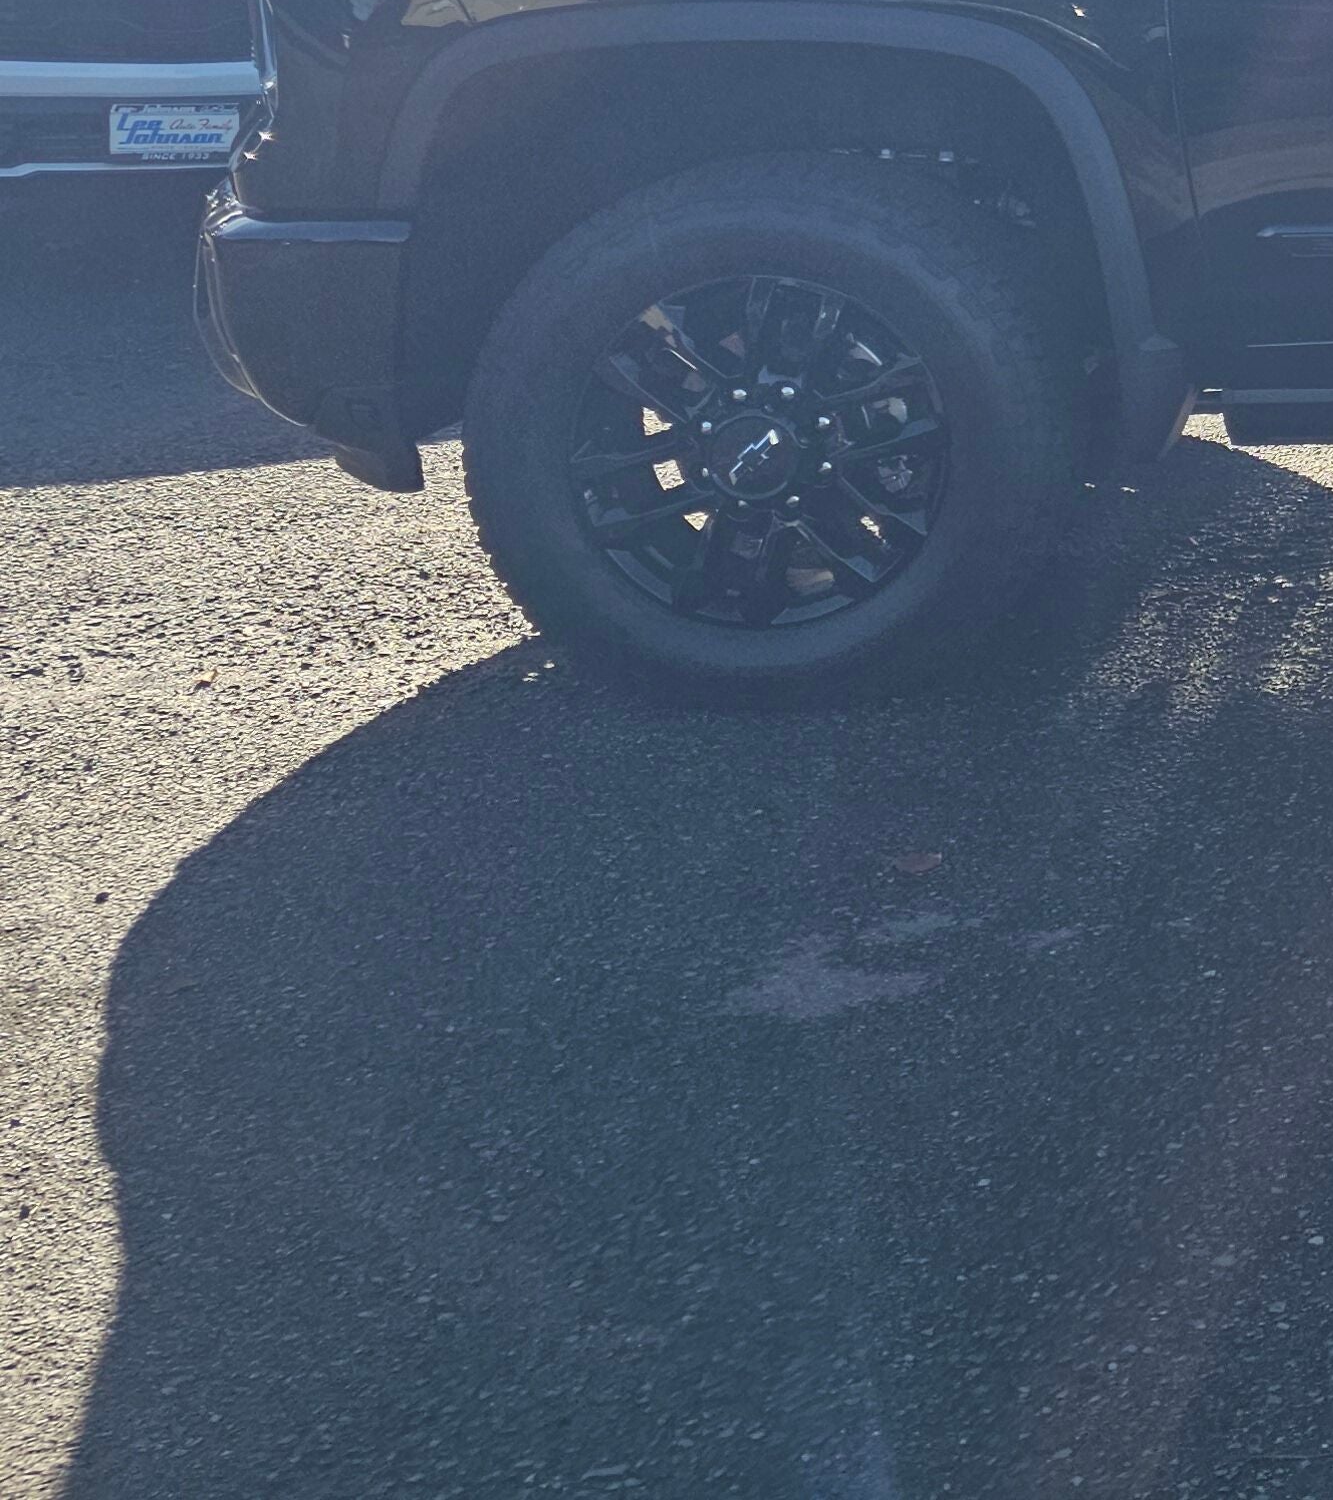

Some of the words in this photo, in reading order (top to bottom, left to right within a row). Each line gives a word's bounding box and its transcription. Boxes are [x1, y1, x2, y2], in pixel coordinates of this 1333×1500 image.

[117, 112, 165, 131] Lee
[119, 128, 226, 145] Johnson
[142, 152, 177, 161] SINCE
